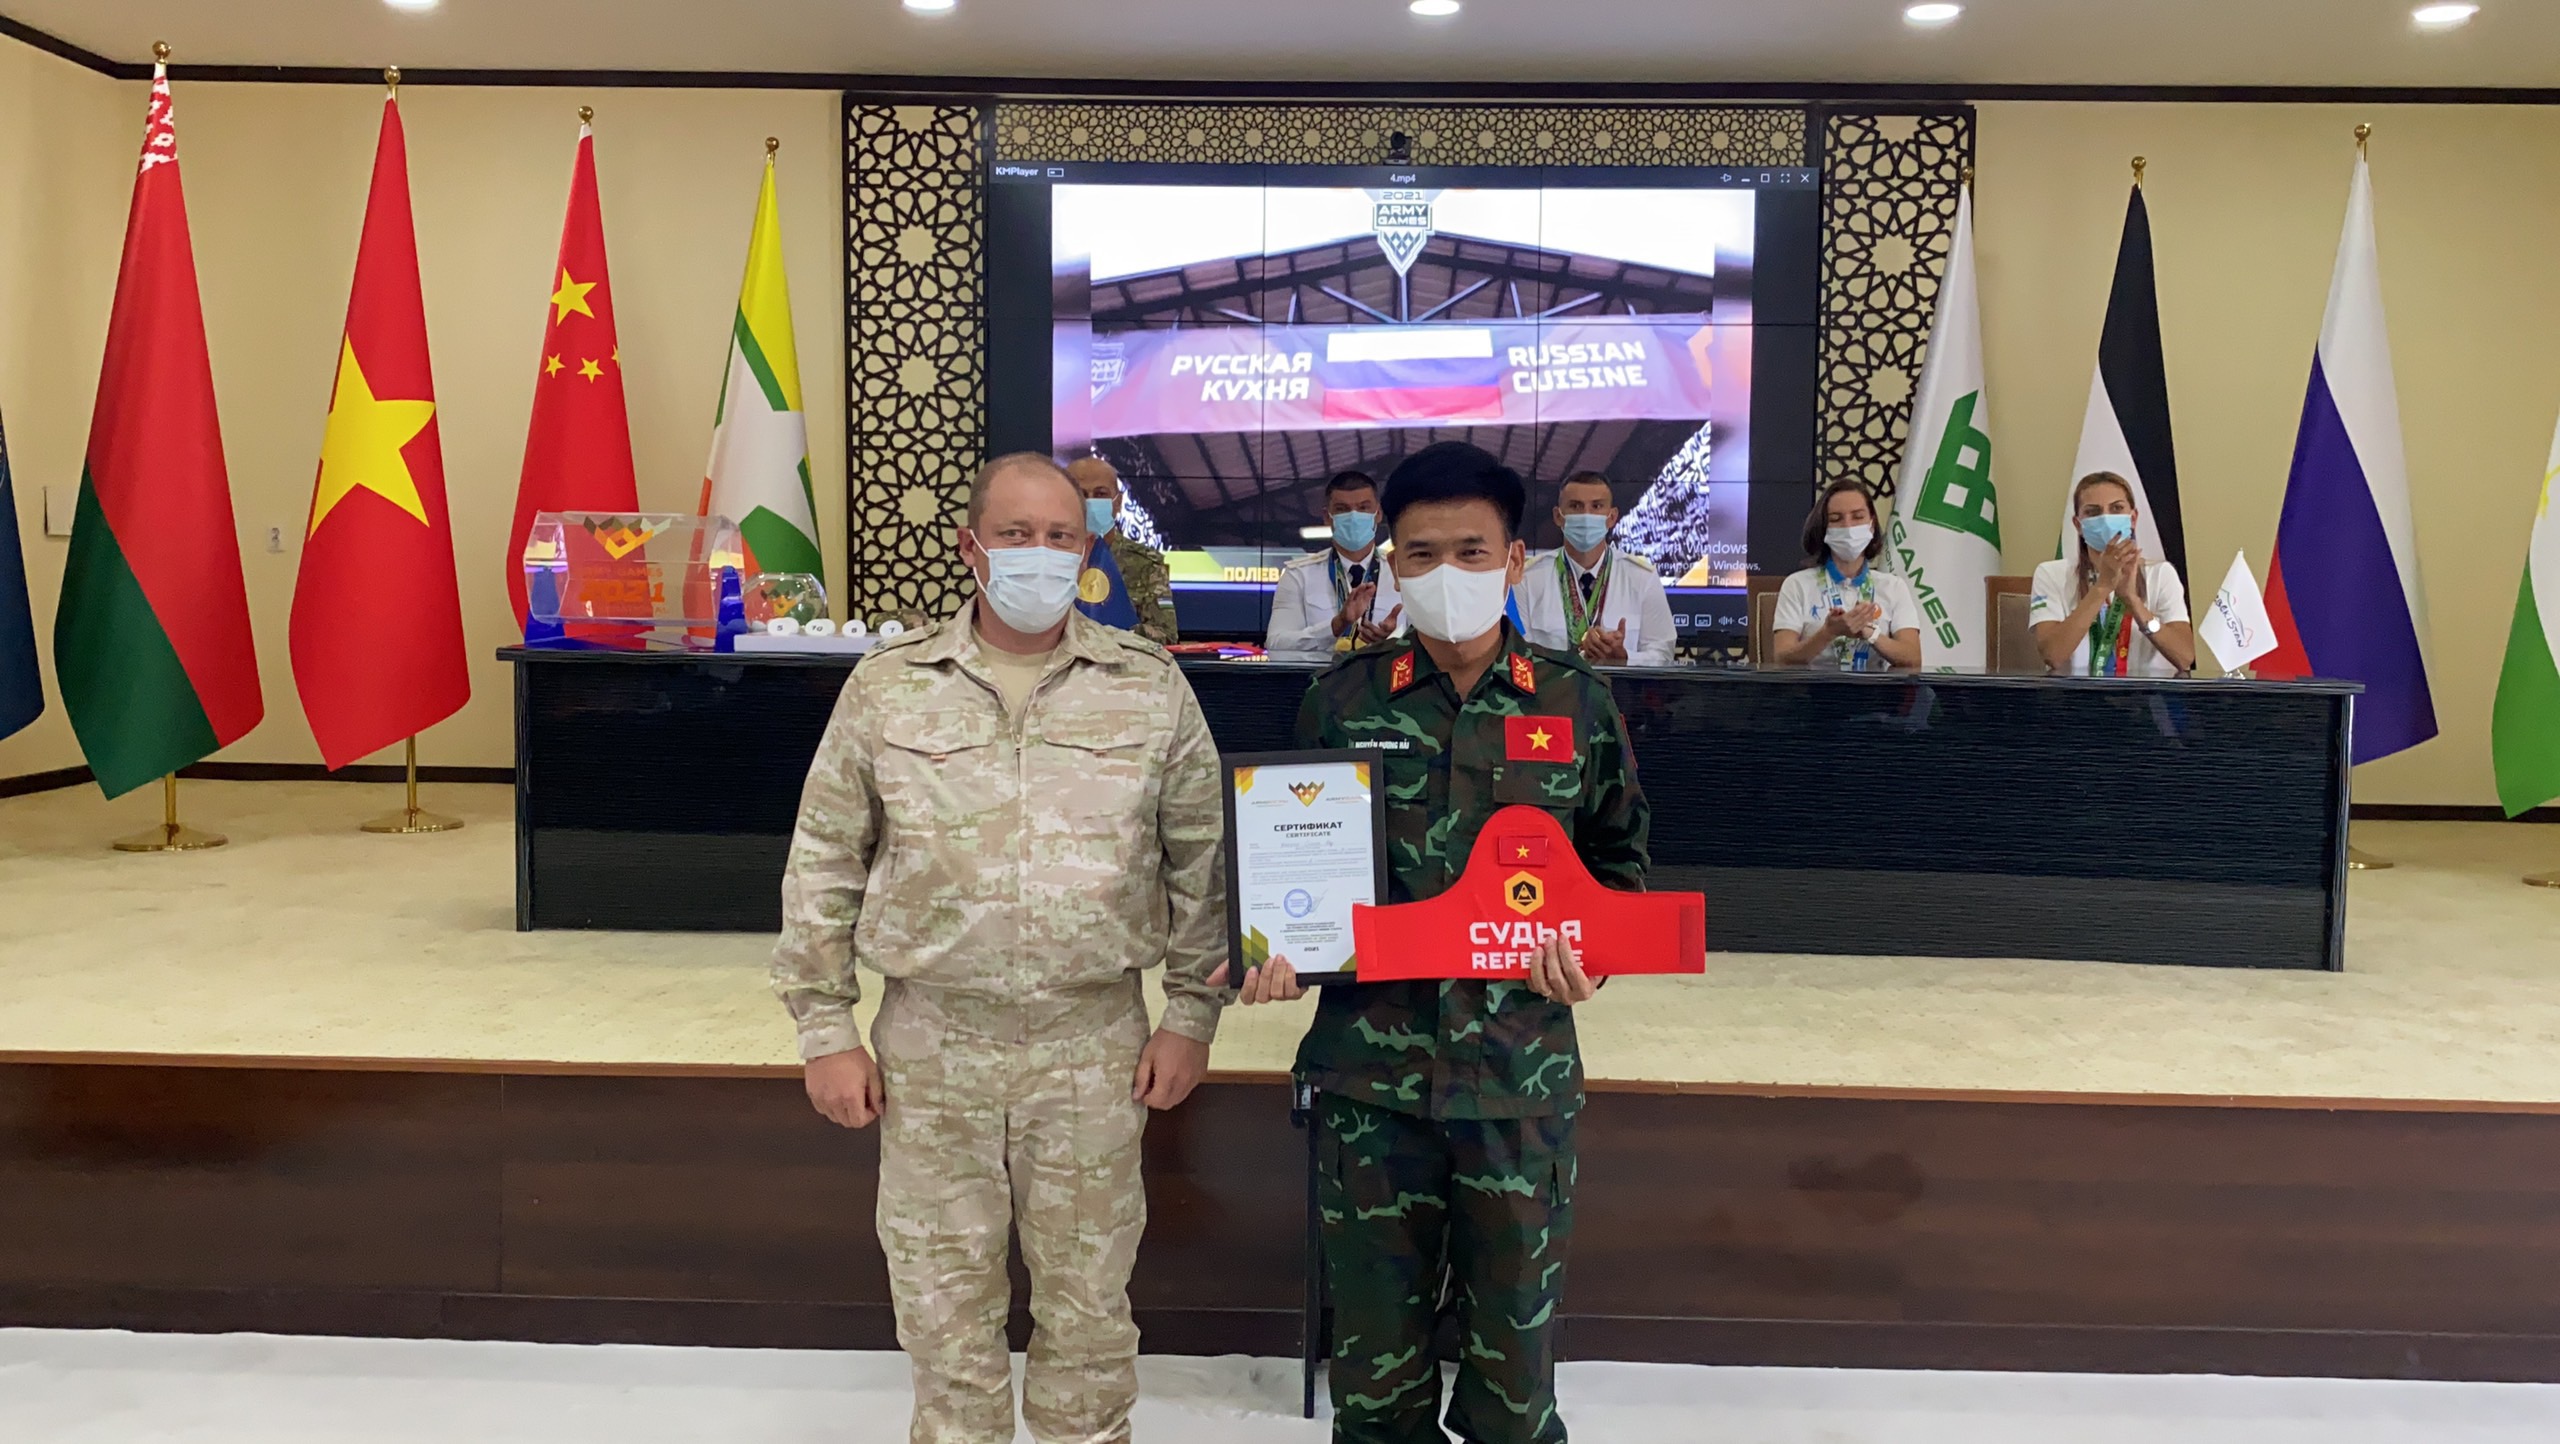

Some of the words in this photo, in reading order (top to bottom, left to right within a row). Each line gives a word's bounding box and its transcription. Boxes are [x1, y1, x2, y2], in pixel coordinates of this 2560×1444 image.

[995, 166, 1039, 177] KMPlayer
[1390, 173, 1416, 184] 4.mp4
[1383, 191, 1422, 200] 2021
[1378, 205, 1426, 215] ARMY
[1377, 216, 1427, 226] GAMES
[1507, 340, 1647, 367] RUSSIAN
[1170, 352, 1313, 376] РУССКАЯ
[1512, 364, 1648, 393] CUISINE
[1201, 377, 1310, 401] КУХНЯ
[1685, 540, 1748, 555] Windows
[1224, 567, 1285, 582] ПОЛЕВ
[1273, 821, 1344, 832] СЕРТИФИКАТ
[1285, 831, 1332, 839] CERTIFICATE
[1469, 919, 1582, 948] СУДЬЯ
[1471, 949, 1584, 970] REFEE
